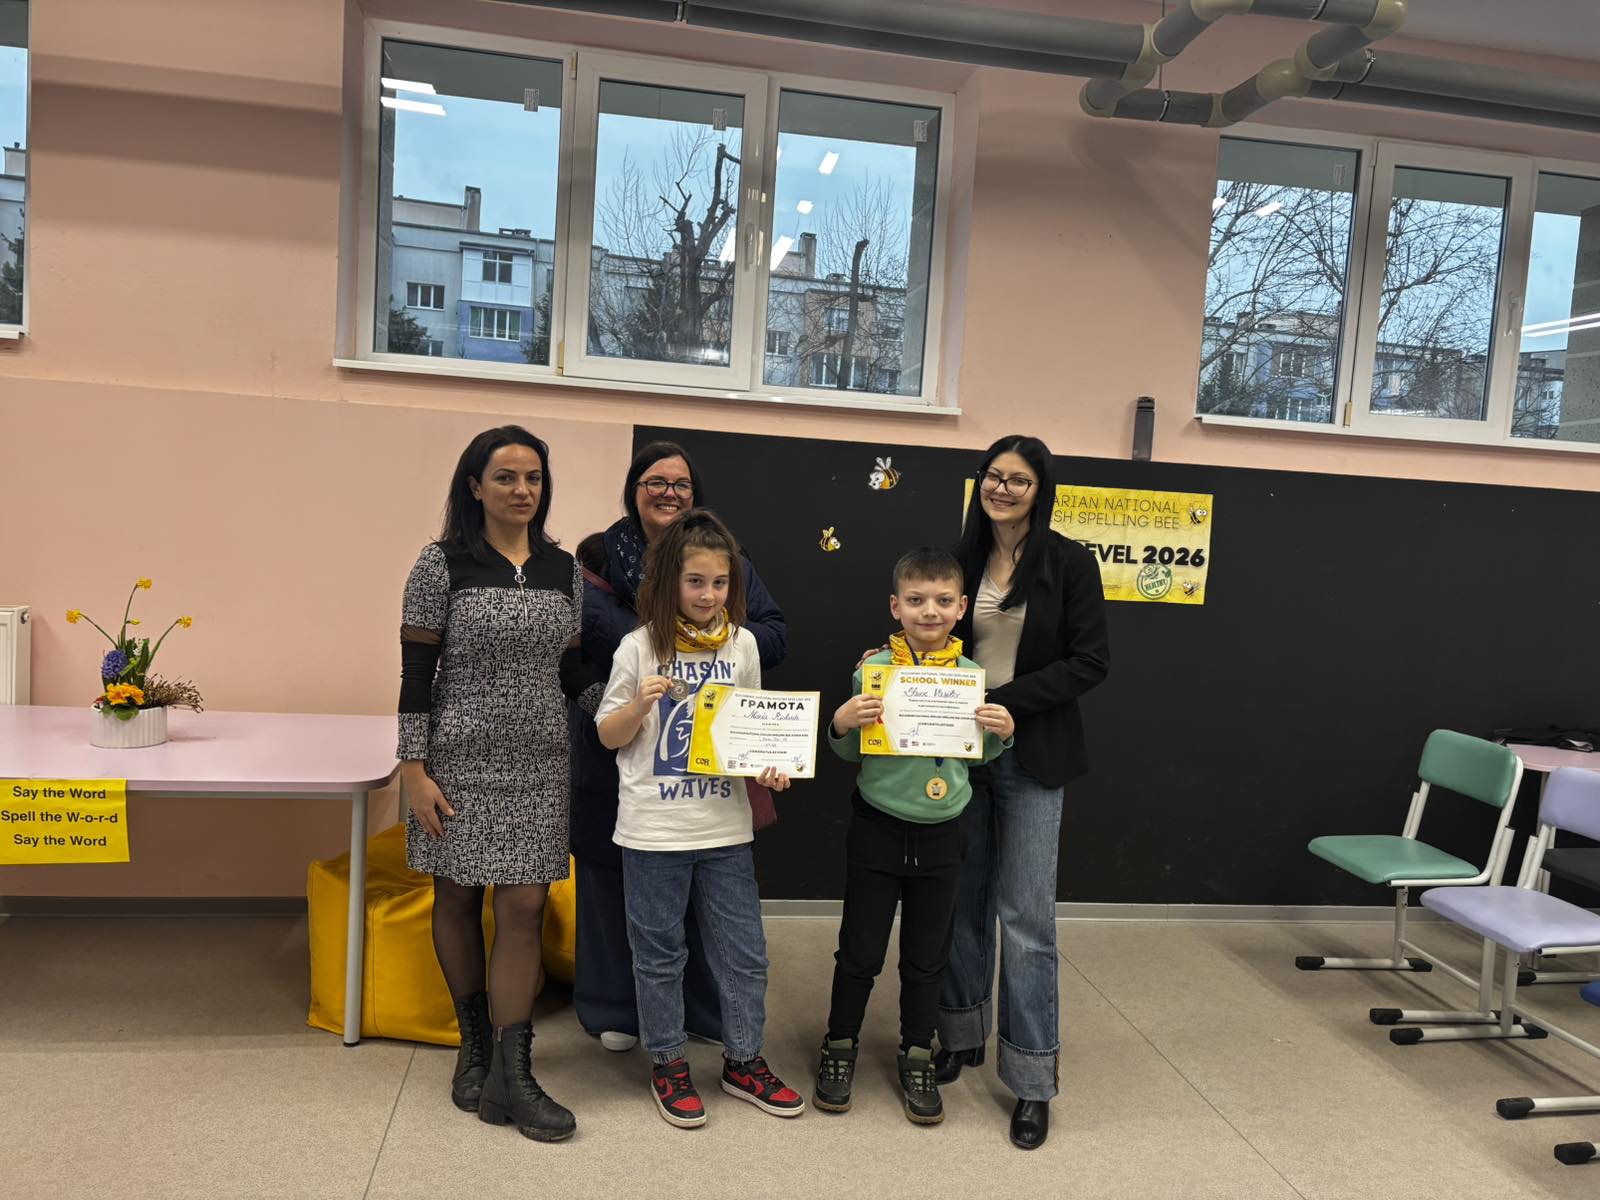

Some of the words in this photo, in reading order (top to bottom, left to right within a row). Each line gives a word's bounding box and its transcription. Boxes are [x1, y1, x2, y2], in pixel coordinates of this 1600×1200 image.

[1104, 497, 1180, 514] NATIONAL
[1078, 511, 1150, 528] SPELLING
[1154, 515, 1180, 529] BEE
[1086, 543, 1138, 564] EVEL
[1142, 545, 1206, 567] 2026
[899, 676, 939, 685] SCHOOL
[941, 678, 977, 687] WINNER
[740, 698, 805, 711] ГРАМОТА
[13, 786, 39, 800] Say
[43, 787, 65, 798] the
[69, 788, 107, 799] Word
[658, 777, 732, 801] WAVES
[0, 810, 36, 823] Spell
[40, 811, 63, 822] the
[66, 812, 118, 823] W-o-r-d
[13, 834, 39, 847] Say
[43, 835, 66, 846] the
[69, 836, 107, 846] Word
